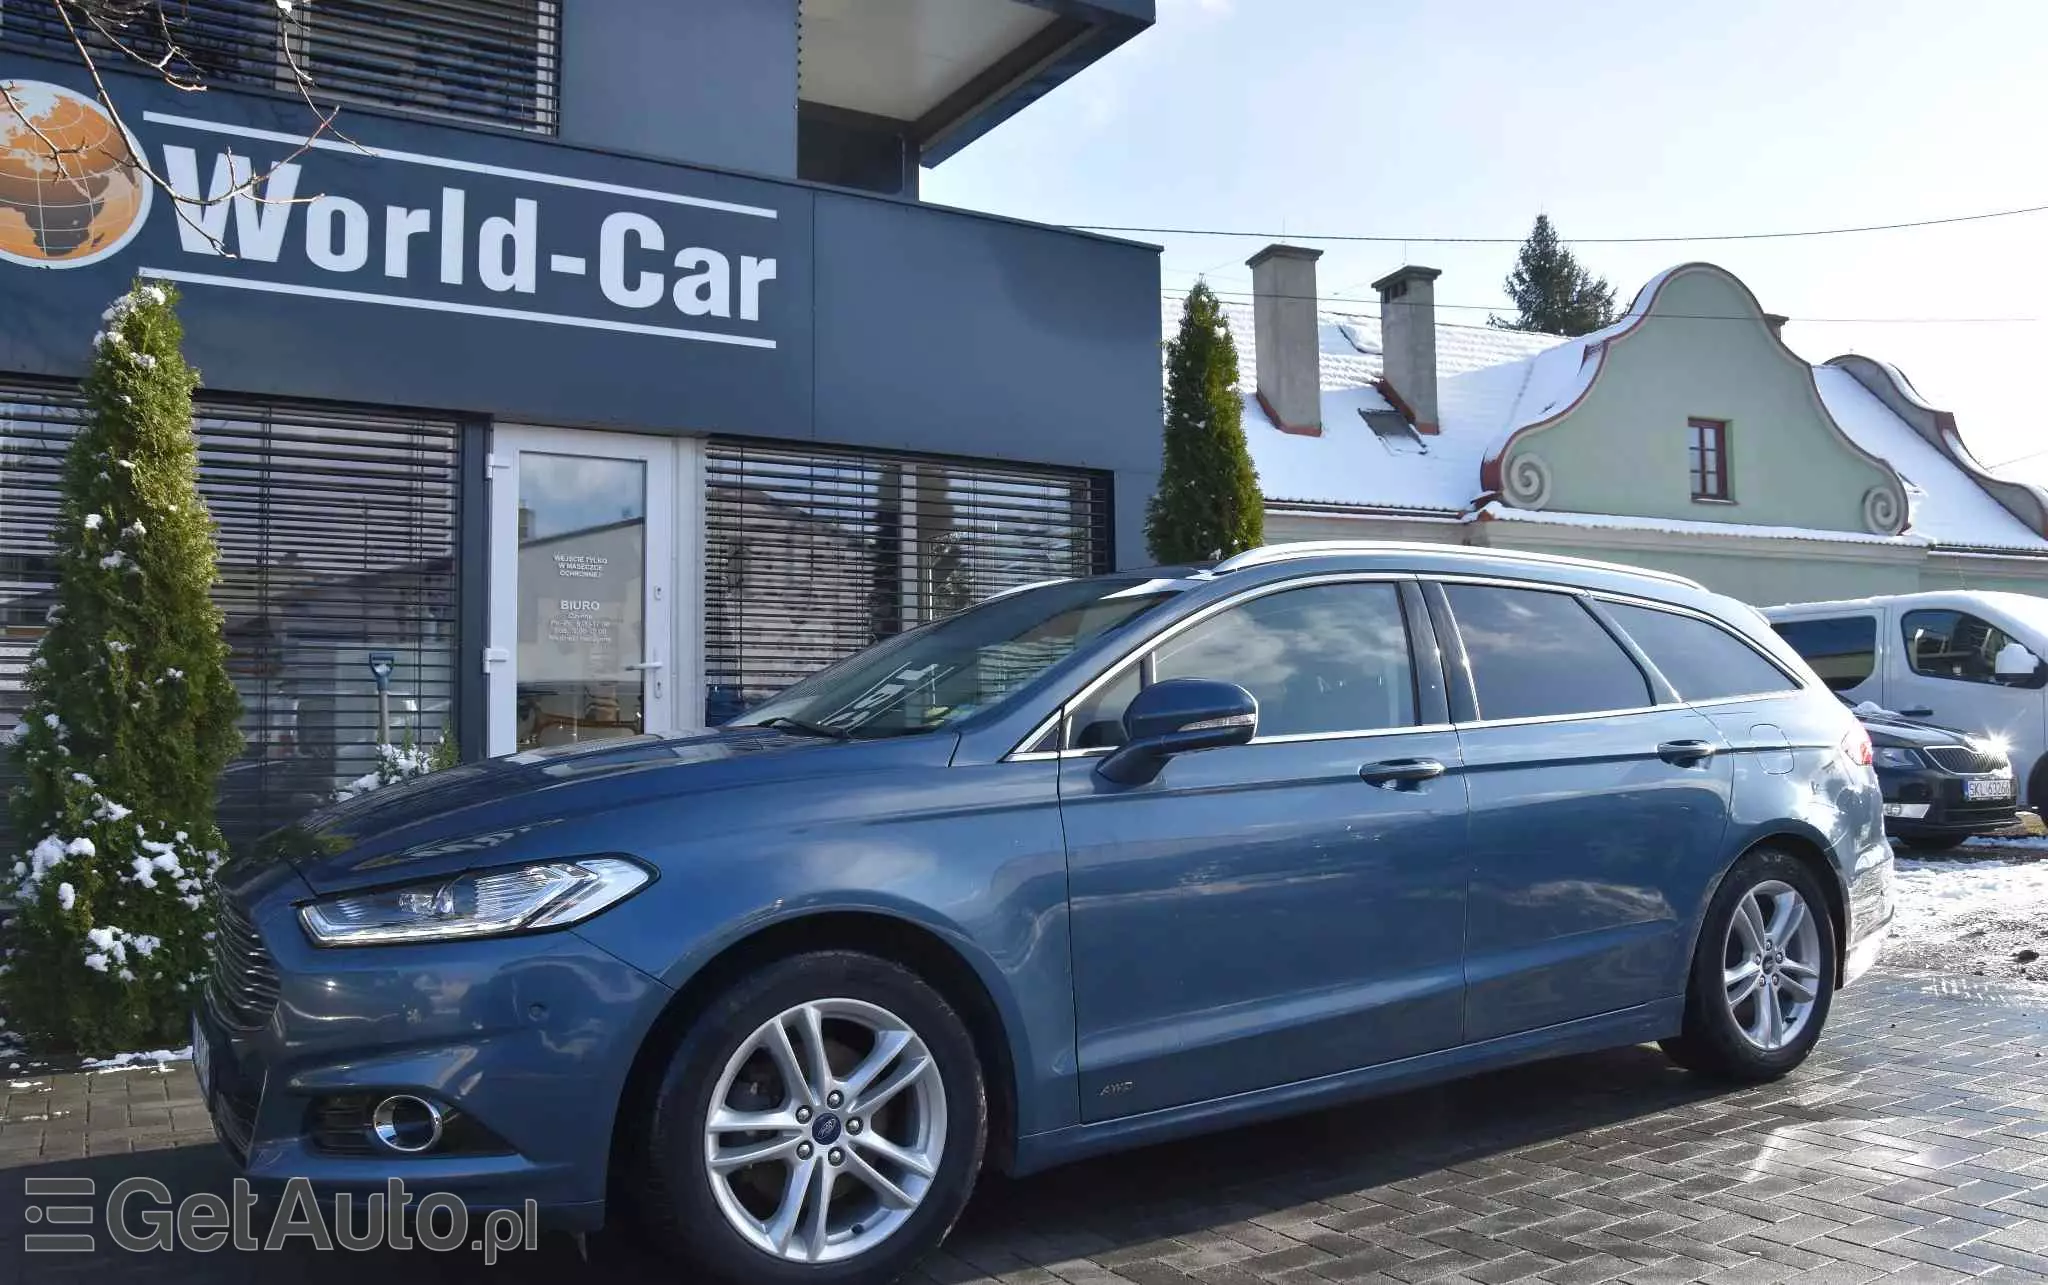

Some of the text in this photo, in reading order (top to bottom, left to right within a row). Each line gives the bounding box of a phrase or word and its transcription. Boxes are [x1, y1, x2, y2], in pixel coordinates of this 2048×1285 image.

[163, 142, 778, 322] World-Car
[586, 556, 608, 564] TYLKO
[560, 600, 600, 610] BIURO
